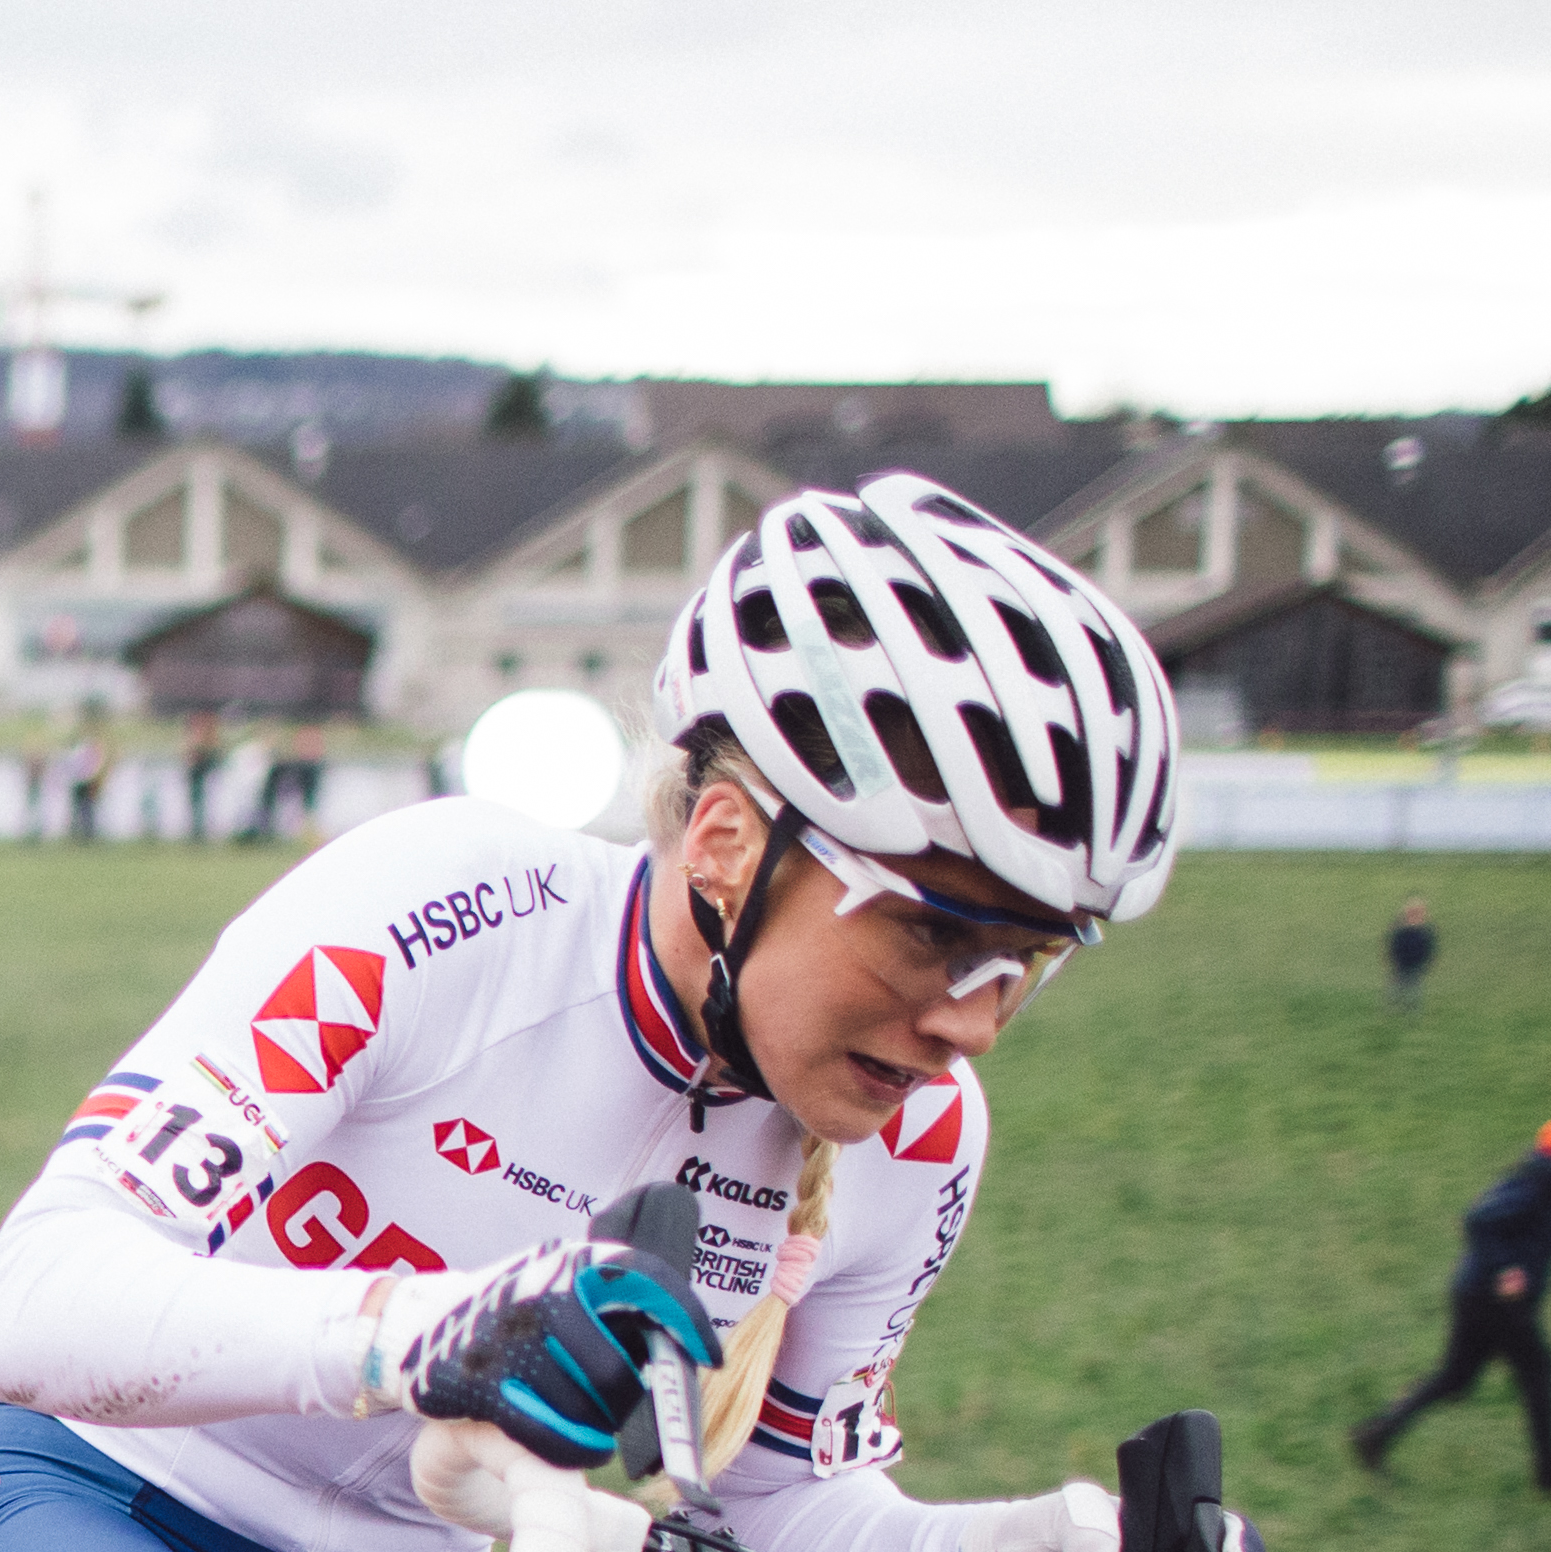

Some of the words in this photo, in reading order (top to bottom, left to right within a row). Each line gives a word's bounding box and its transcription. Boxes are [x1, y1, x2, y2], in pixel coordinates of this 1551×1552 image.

[387, 882, 503, 970] HSBC
[503, 863, 568, 918] UK
[228, 1087, 266, 1126] UCI
[138, 1104, 243, 1207] 13
[502, 1162, 566, 1203] HSBC
[565, 1190, 598, 1217] UK
[732, 1237, 761, 1251] HSBC
[692, 1265, 762, 1295] YCLING
